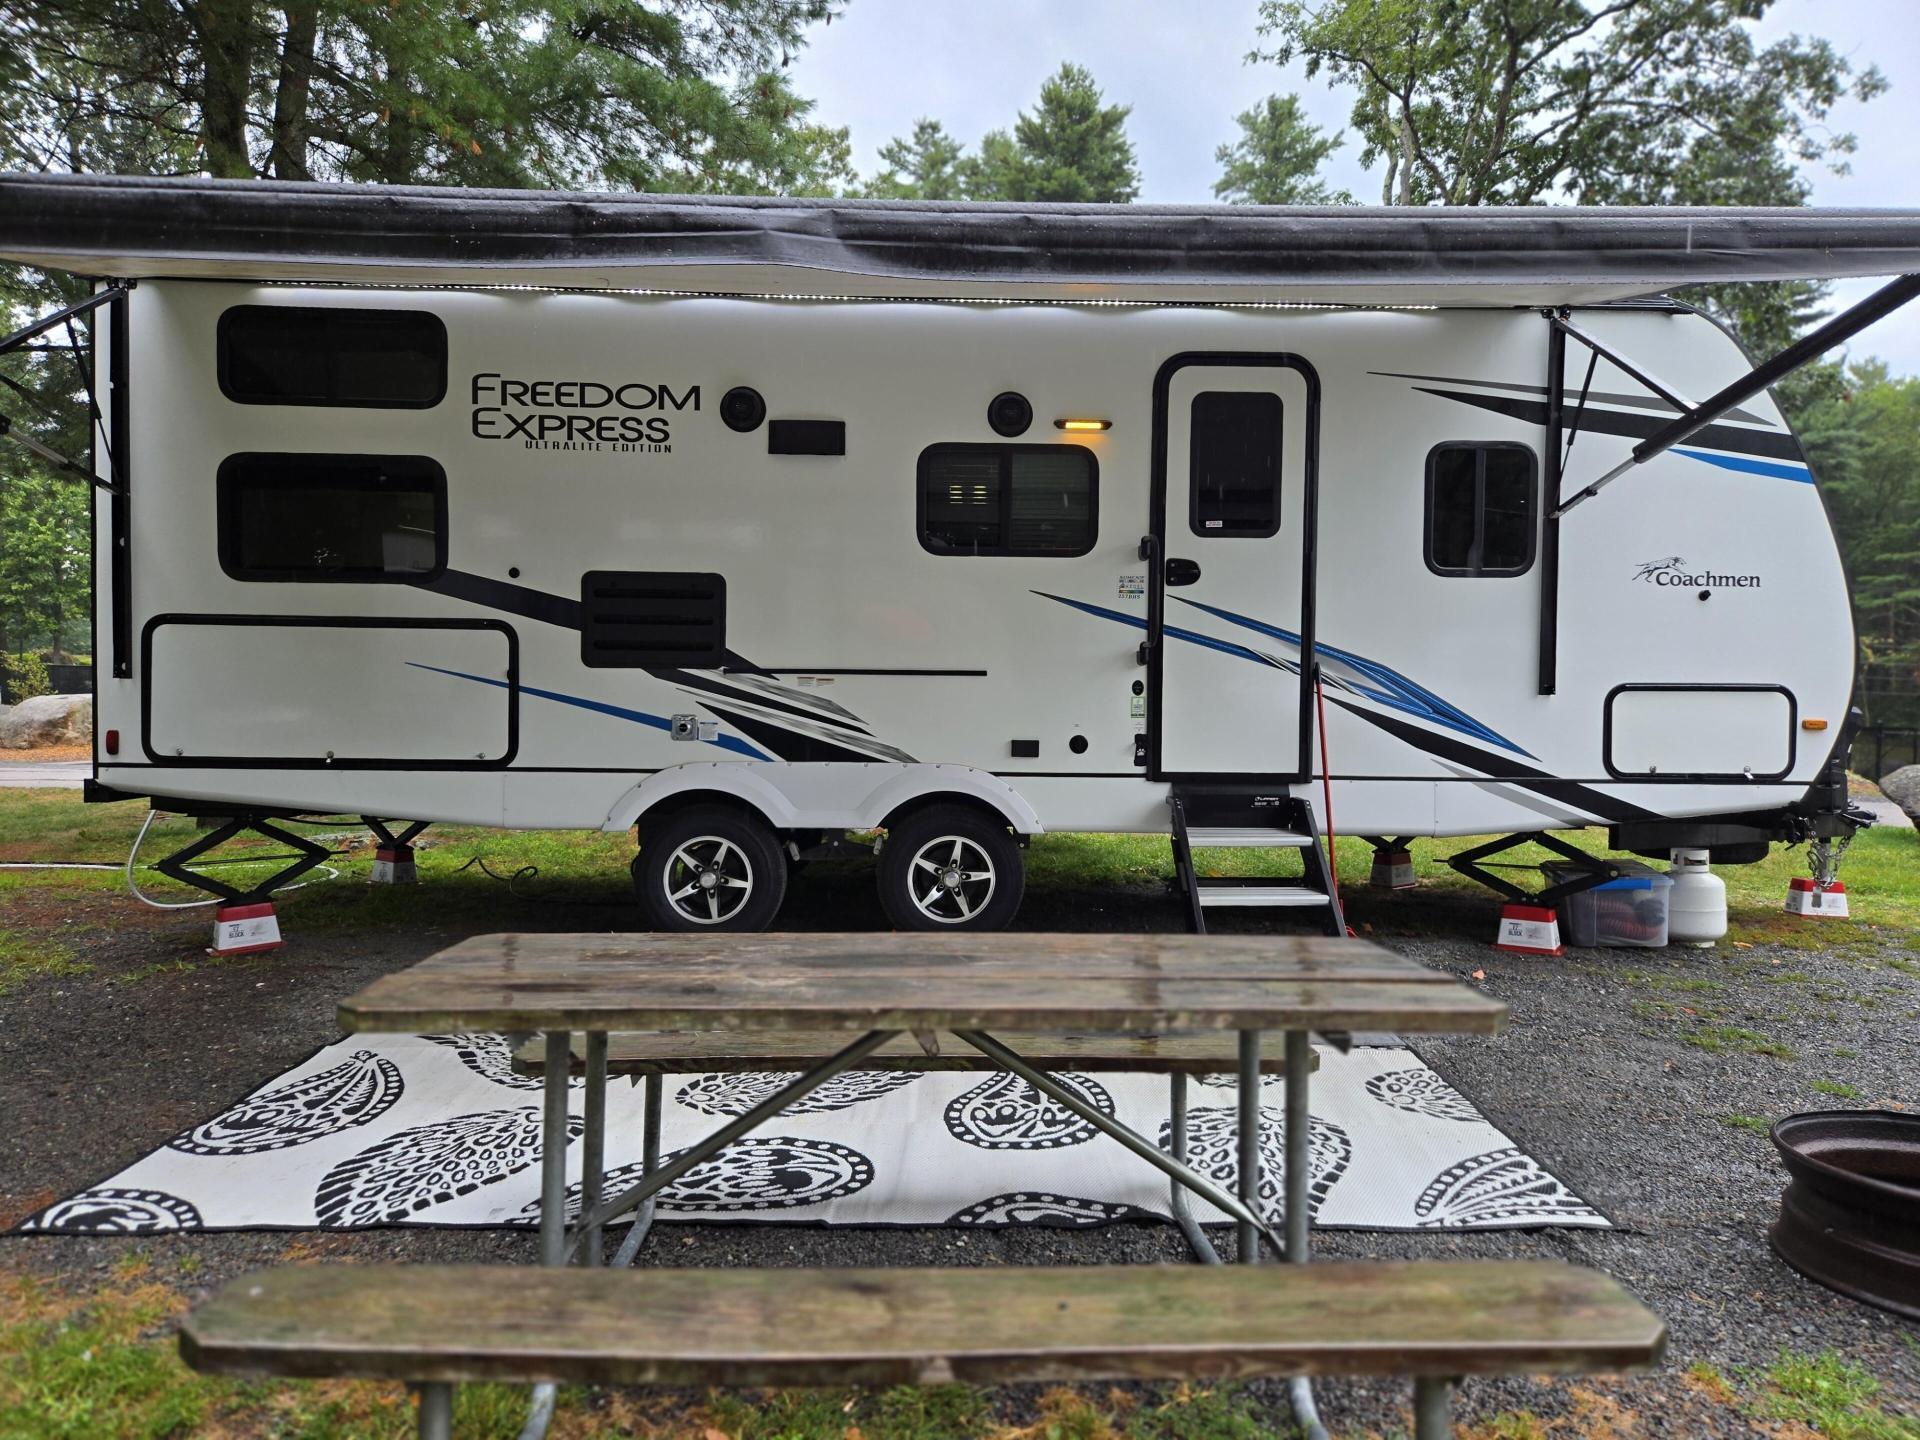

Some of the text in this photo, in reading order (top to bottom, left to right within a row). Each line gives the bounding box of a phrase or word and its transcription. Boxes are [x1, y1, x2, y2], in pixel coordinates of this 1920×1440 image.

[472, 373, 700, 411] FREEDOM
[472, 407, 670, 443] EXPRESS
[525, 440, 671, 453] ULTRALITE EDITION
[1655, 571, 1761, 588] Coachmen
